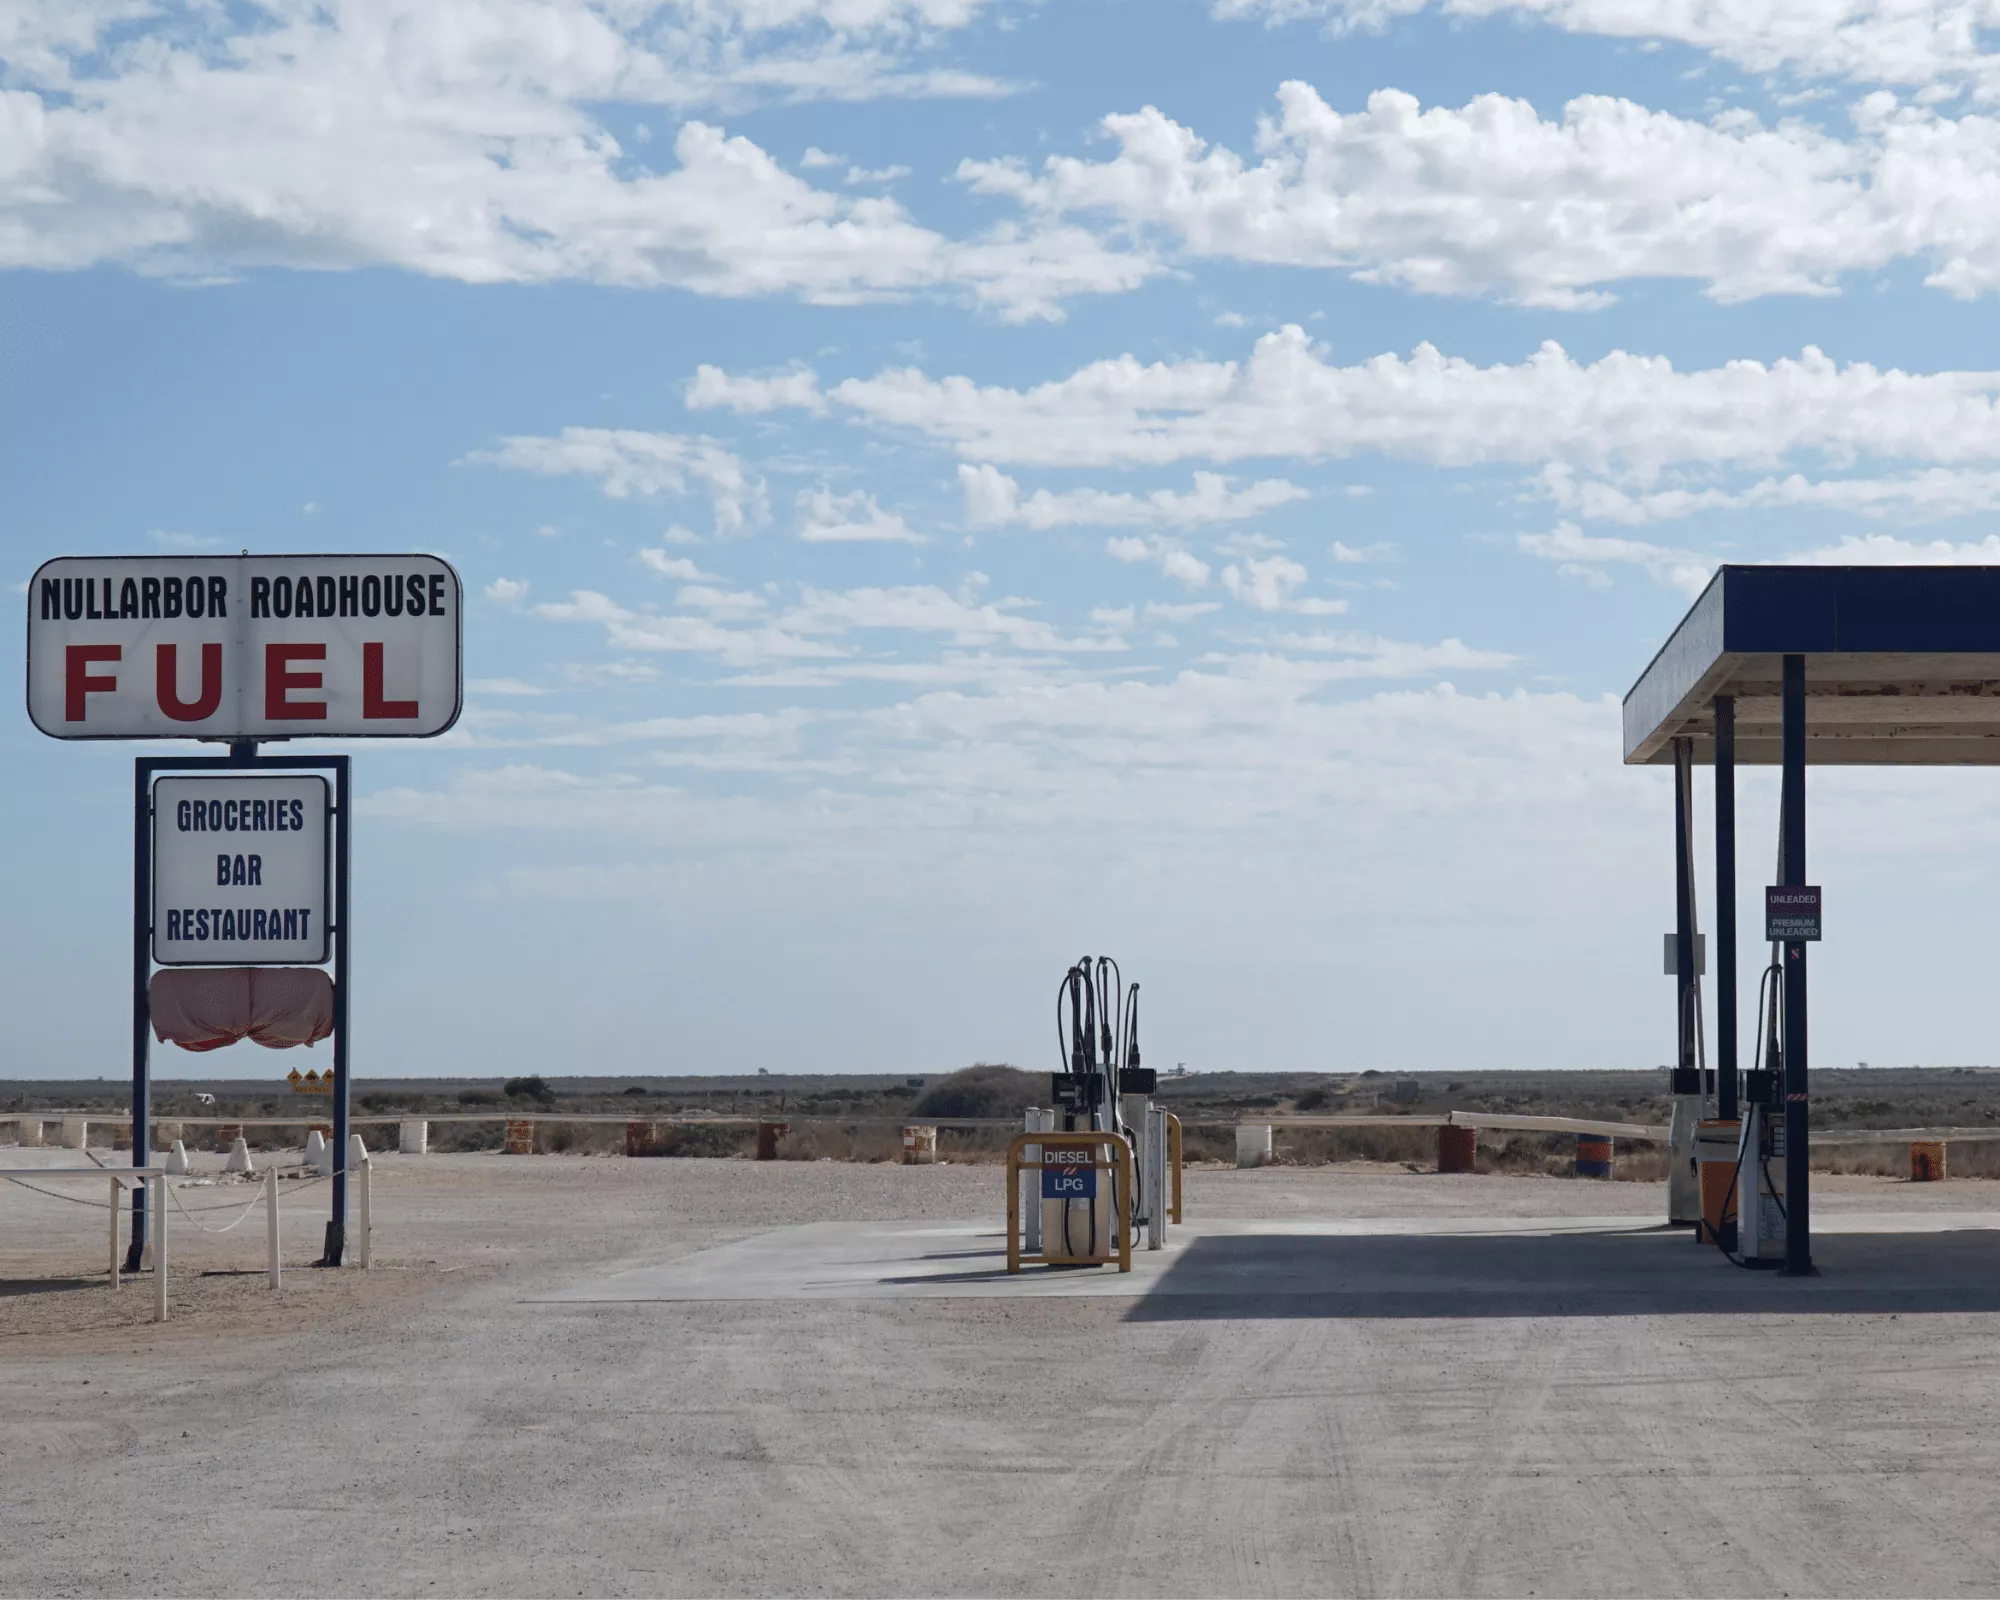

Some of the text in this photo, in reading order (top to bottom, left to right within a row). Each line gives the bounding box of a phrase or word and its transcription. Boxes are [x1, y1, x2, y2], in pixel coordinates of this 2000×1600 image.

[41, 574, 445, 620] NULLARBOR ROADHOUSE
[65, 642, 419, 722] FUEL
[177, 799, 304, 831] GROCERIES
[217, 854, 262, 886] BAR
[1770, 895, 1817, 903] UNLEADED
[167, 909, 311, 941] RESTAURANT
[1769, 928, 1818, 936] UNLEADED
[1772, 919, 1815, 927] PREMIUM
[1045, 1151, 1092, 1163] DIESEL
[1055, 1178, 1083, 1190] LPG
